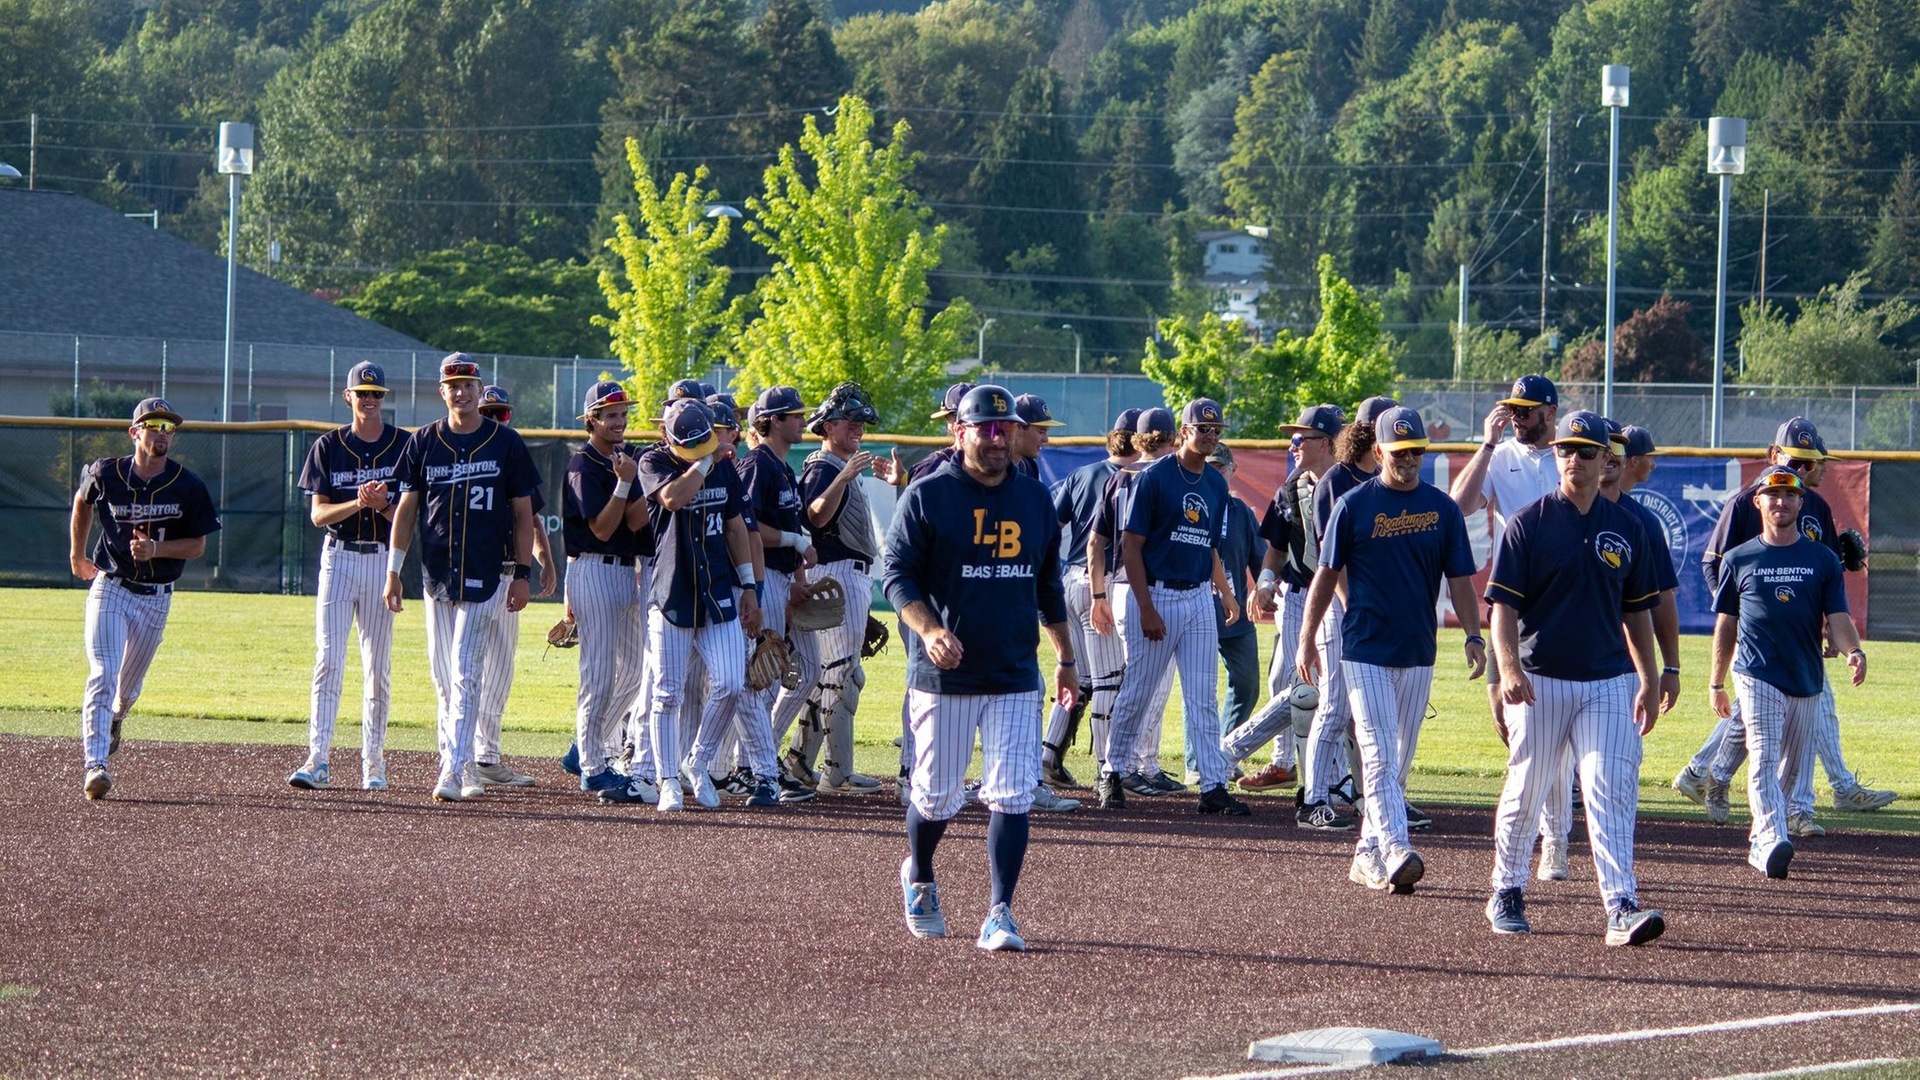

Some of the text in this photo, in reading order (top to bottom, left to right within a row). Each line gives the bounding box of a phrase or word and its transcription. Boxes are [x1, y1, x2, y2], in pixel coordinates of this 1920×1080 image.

[992, 393, 1007, 412] LB
[469, 486, 494, 510] 21
[1643, 494, 1679, 527] DISTRICT
[973, 508, 1021, 558] LB
[1170, 531, 1212, 548] BASEBALL
[961, 564, 1034, 578] BASEBALL
[1752, 566, 1814, 576] LINN-BENTON
[1763, 575, 1804, 583] BASEBALL
